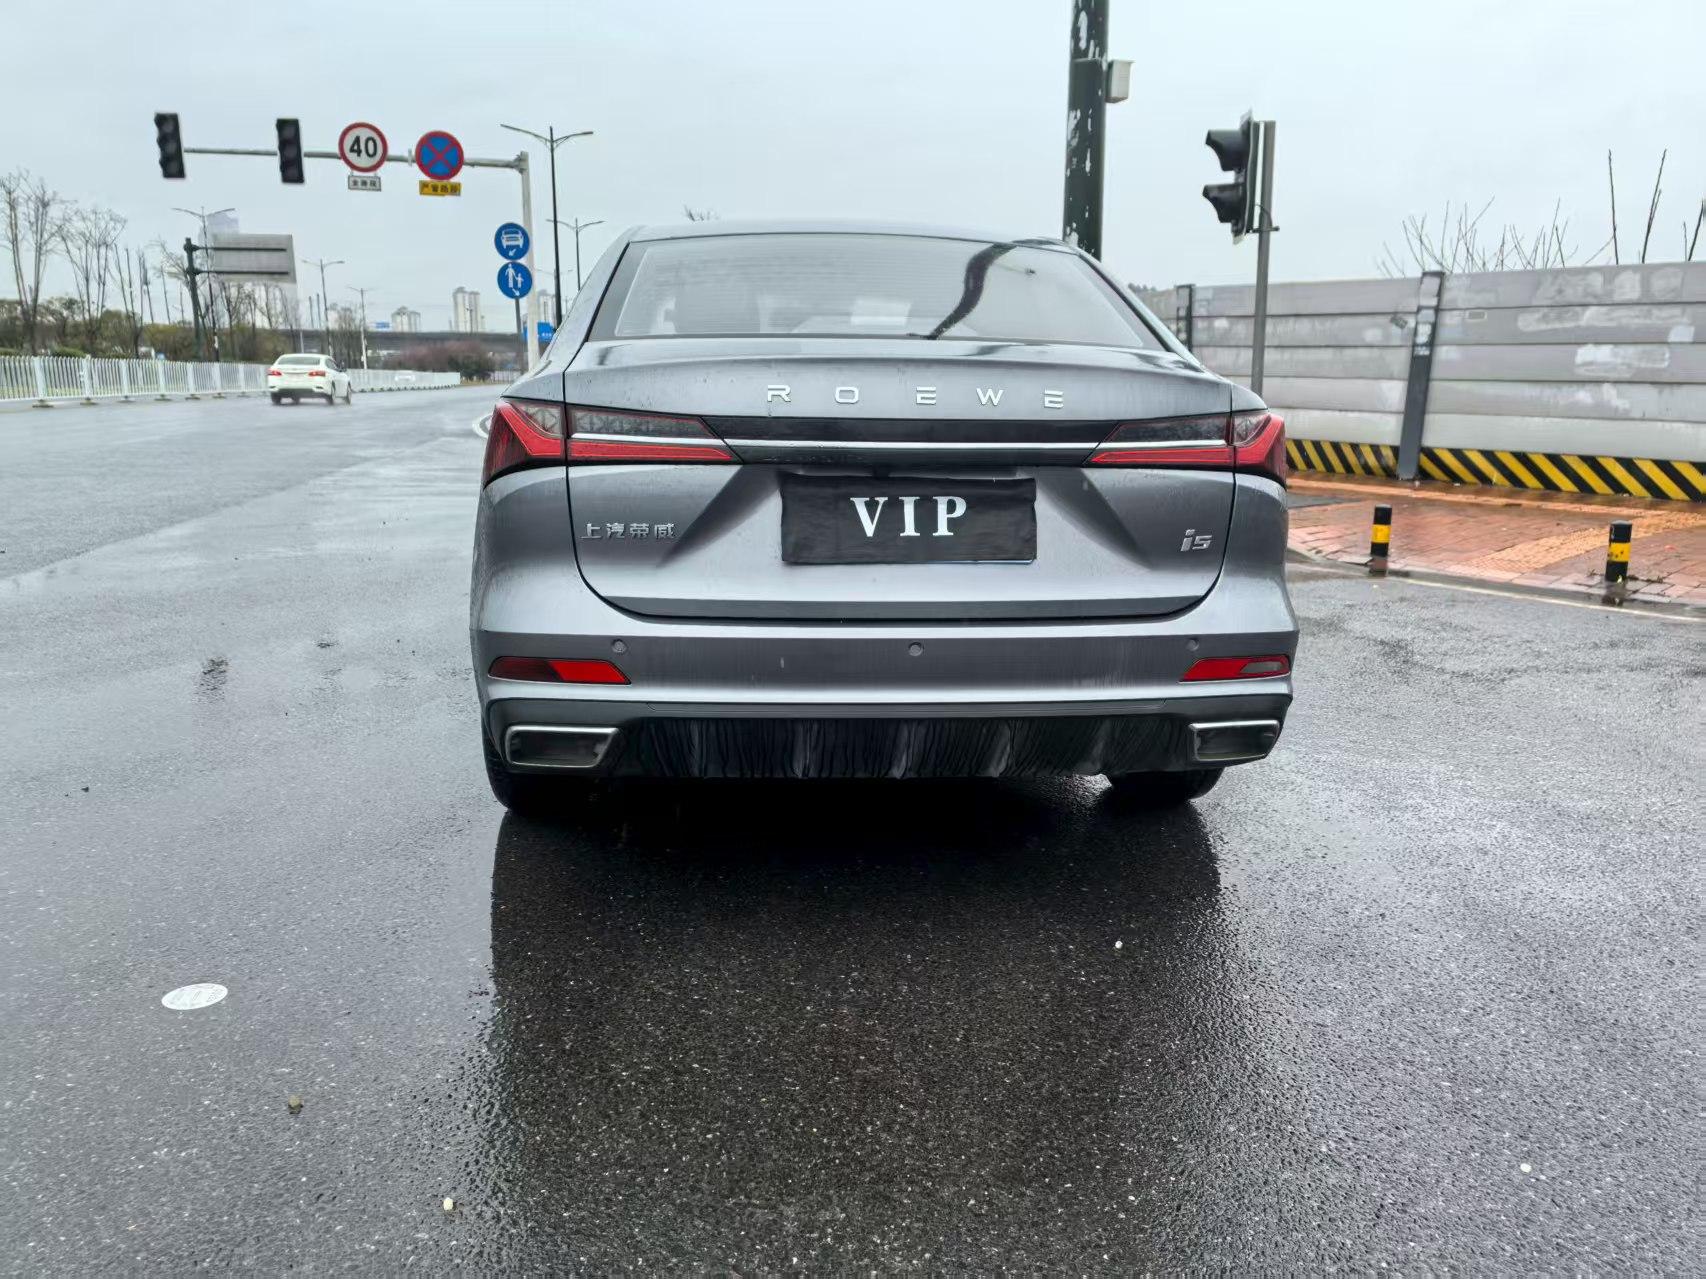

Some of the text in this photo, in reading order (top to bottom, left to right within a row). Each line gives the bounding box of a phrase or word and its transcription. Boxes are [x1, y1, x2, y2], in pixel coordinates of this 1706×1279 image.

[349, 135, 378, 158] 40
[767, 384, 1064, 409] ROEWE
[849, 495, 967, 538] VIP
[580, 522, 675, 539] 上汽荣威
[1180, 529, 1213, 552] i5
